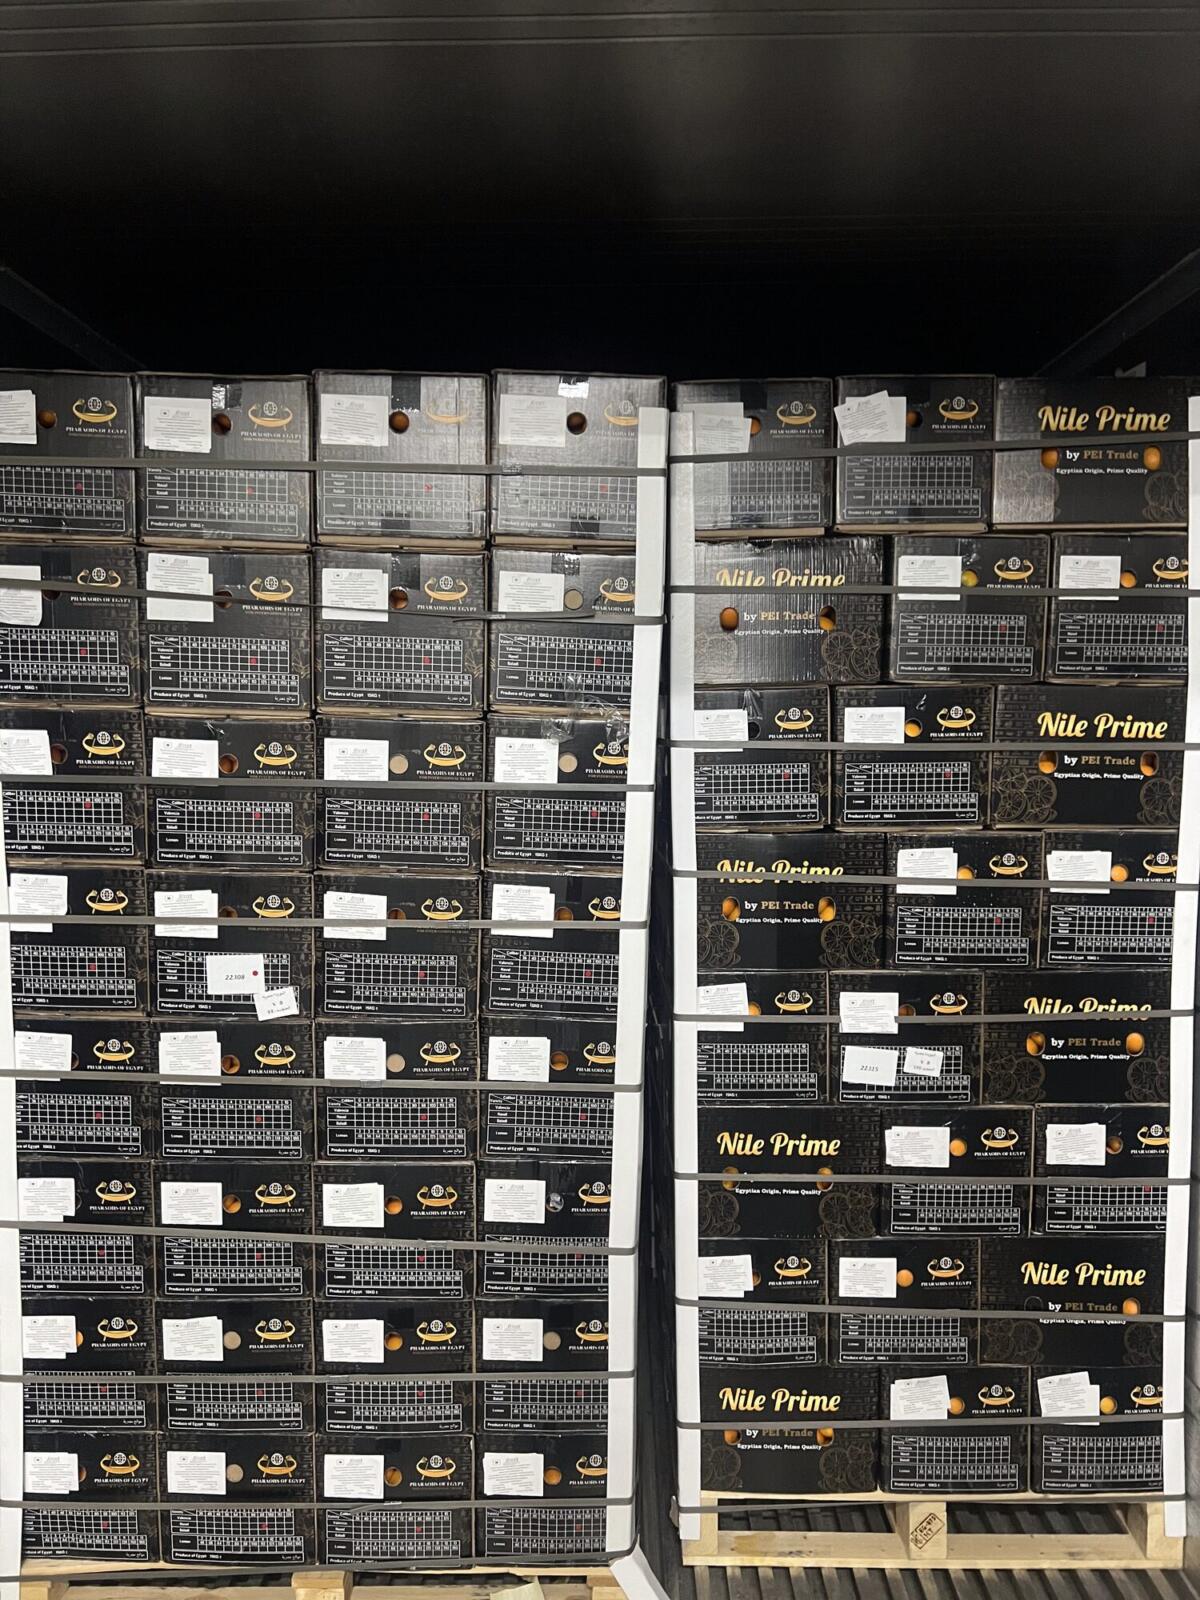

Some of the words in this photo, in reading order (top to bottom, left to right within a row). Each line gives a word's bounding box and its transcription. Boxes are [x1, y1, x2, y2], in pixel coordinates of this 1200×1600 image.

[1038, 405, 1090, 432] Nile
[1095, 405, 1171, 432] Prime
[1066, 450, 1080, 461] by
[1084, 451, 1102, 460] PEI
[1108, 450, 1139, 460] Trade
[744, 614, 758, 623] by
[760, 612, 780, 620] PEI
[784, 612, 815, 620] Trade
[1037, 712, 1088, 738] Nile
[1094, 714, 1168, 738] Prime
[1064, 756, 1078, 766] by
[1081, 756, 1100, 764] PEI
[1104, 756, 1136, 765] Trade
[744, 901, 758, 911] by
[761, 902, 780, 910] PEI
[784, 902, 814, 910] Trade
[1051, 1038, 1064, 1048] by
[1068, 1038, 1086, 1046] PEI
[1091, 1038, 1121, 1046] Trade
[716, 1132, 764, 1155] Nile
[770, 1132, 840, 1156] Prime
[1020, 1262, 1070, 1285] Nile
[1075, 1262, 1146, 1286] Prime
[1048, 1302, 1062, 1312] by
[1064, 1303, 1084, 1311] PEI
[1086, 1303, 1118, 1312] Trade
[719, 1388, 766, 1411] Nile
[772, 1388, 841, 1412] Prime
[746, 1429, 758, 1438] by
